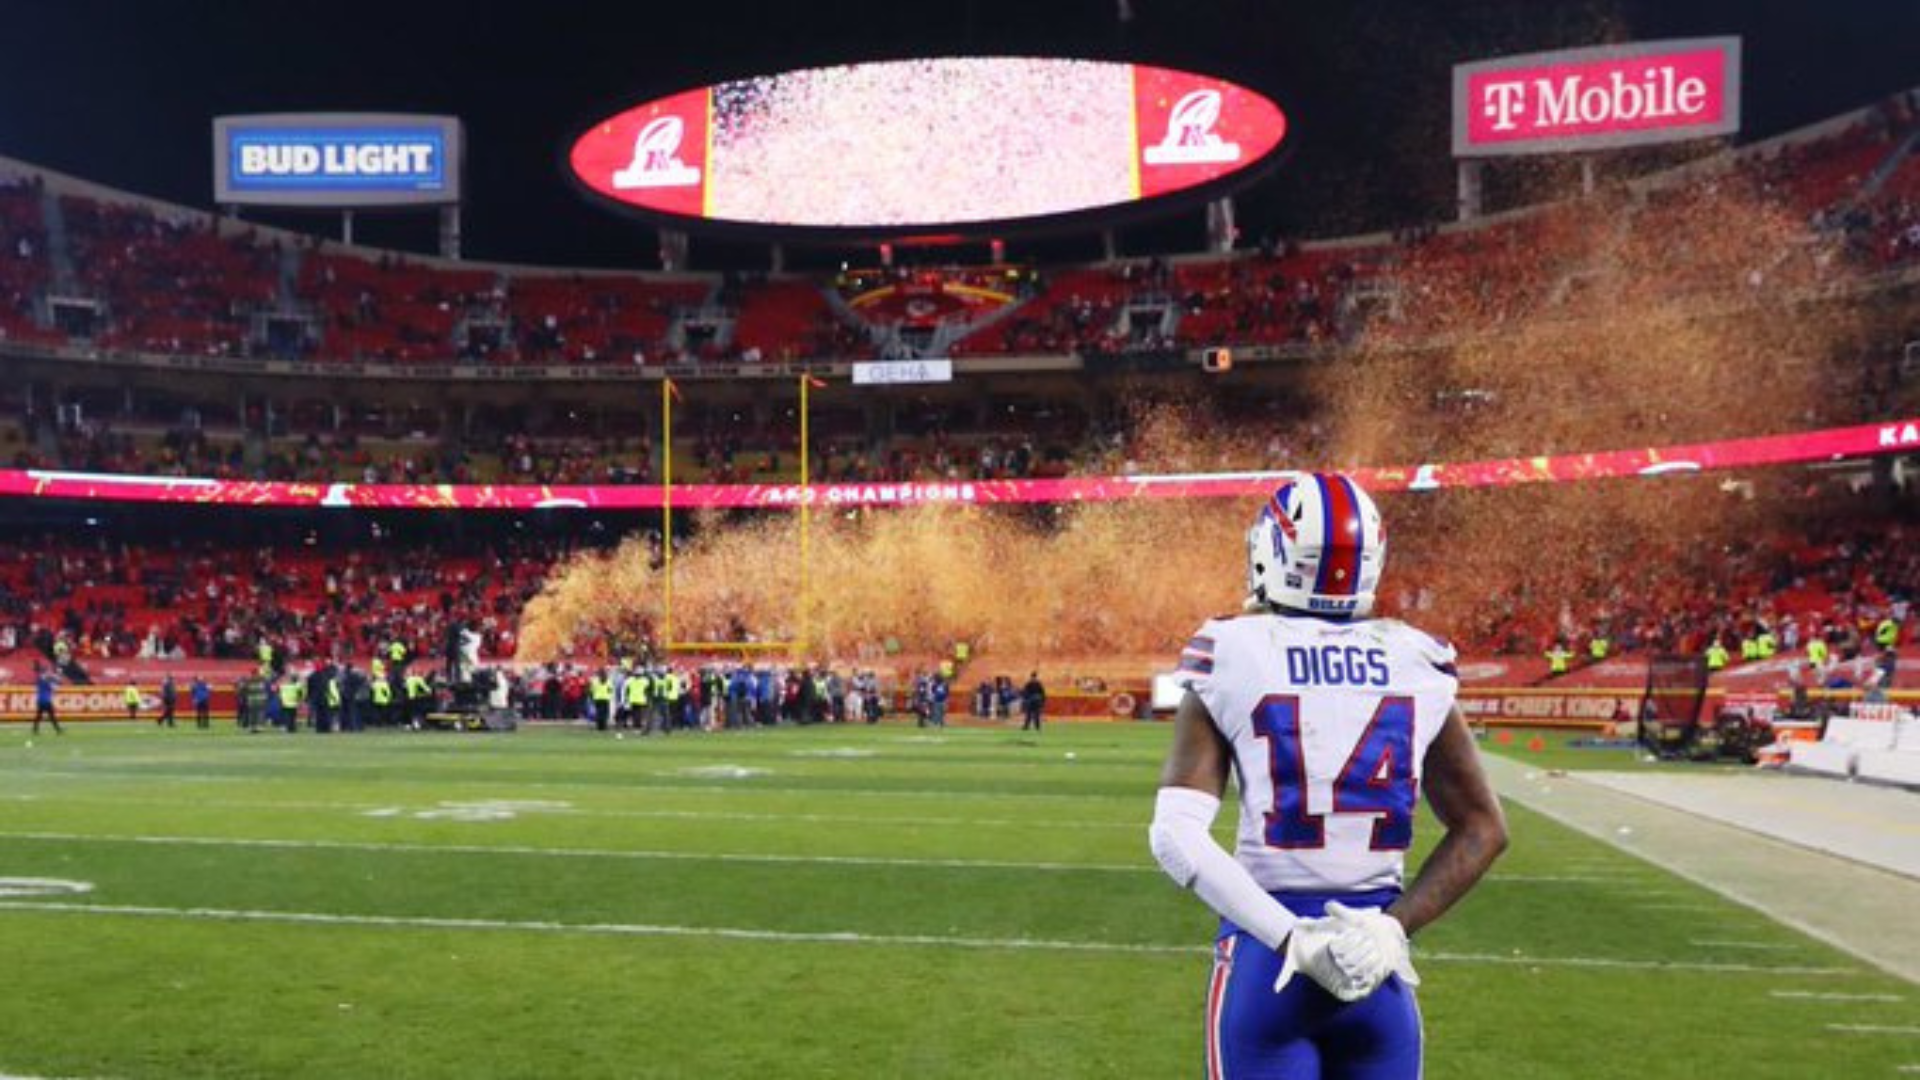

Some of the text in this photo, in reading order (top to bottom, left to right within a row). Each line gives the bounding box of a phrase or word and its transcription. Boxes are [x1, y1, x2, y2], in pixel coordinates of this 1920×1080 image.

[1534, 66, 1707, 127] Mobile
[241, 144, 433, 174] BUD LIGHT
[827, 483, 975, 502] CHAMPIONS
[1308, 597, 1358, 611] BILLS
[1287, 646, 1389, 685] DIGGS
[10, 693, 126, 711] KIGDOM
[1251, 693, 1417, 851] 14
